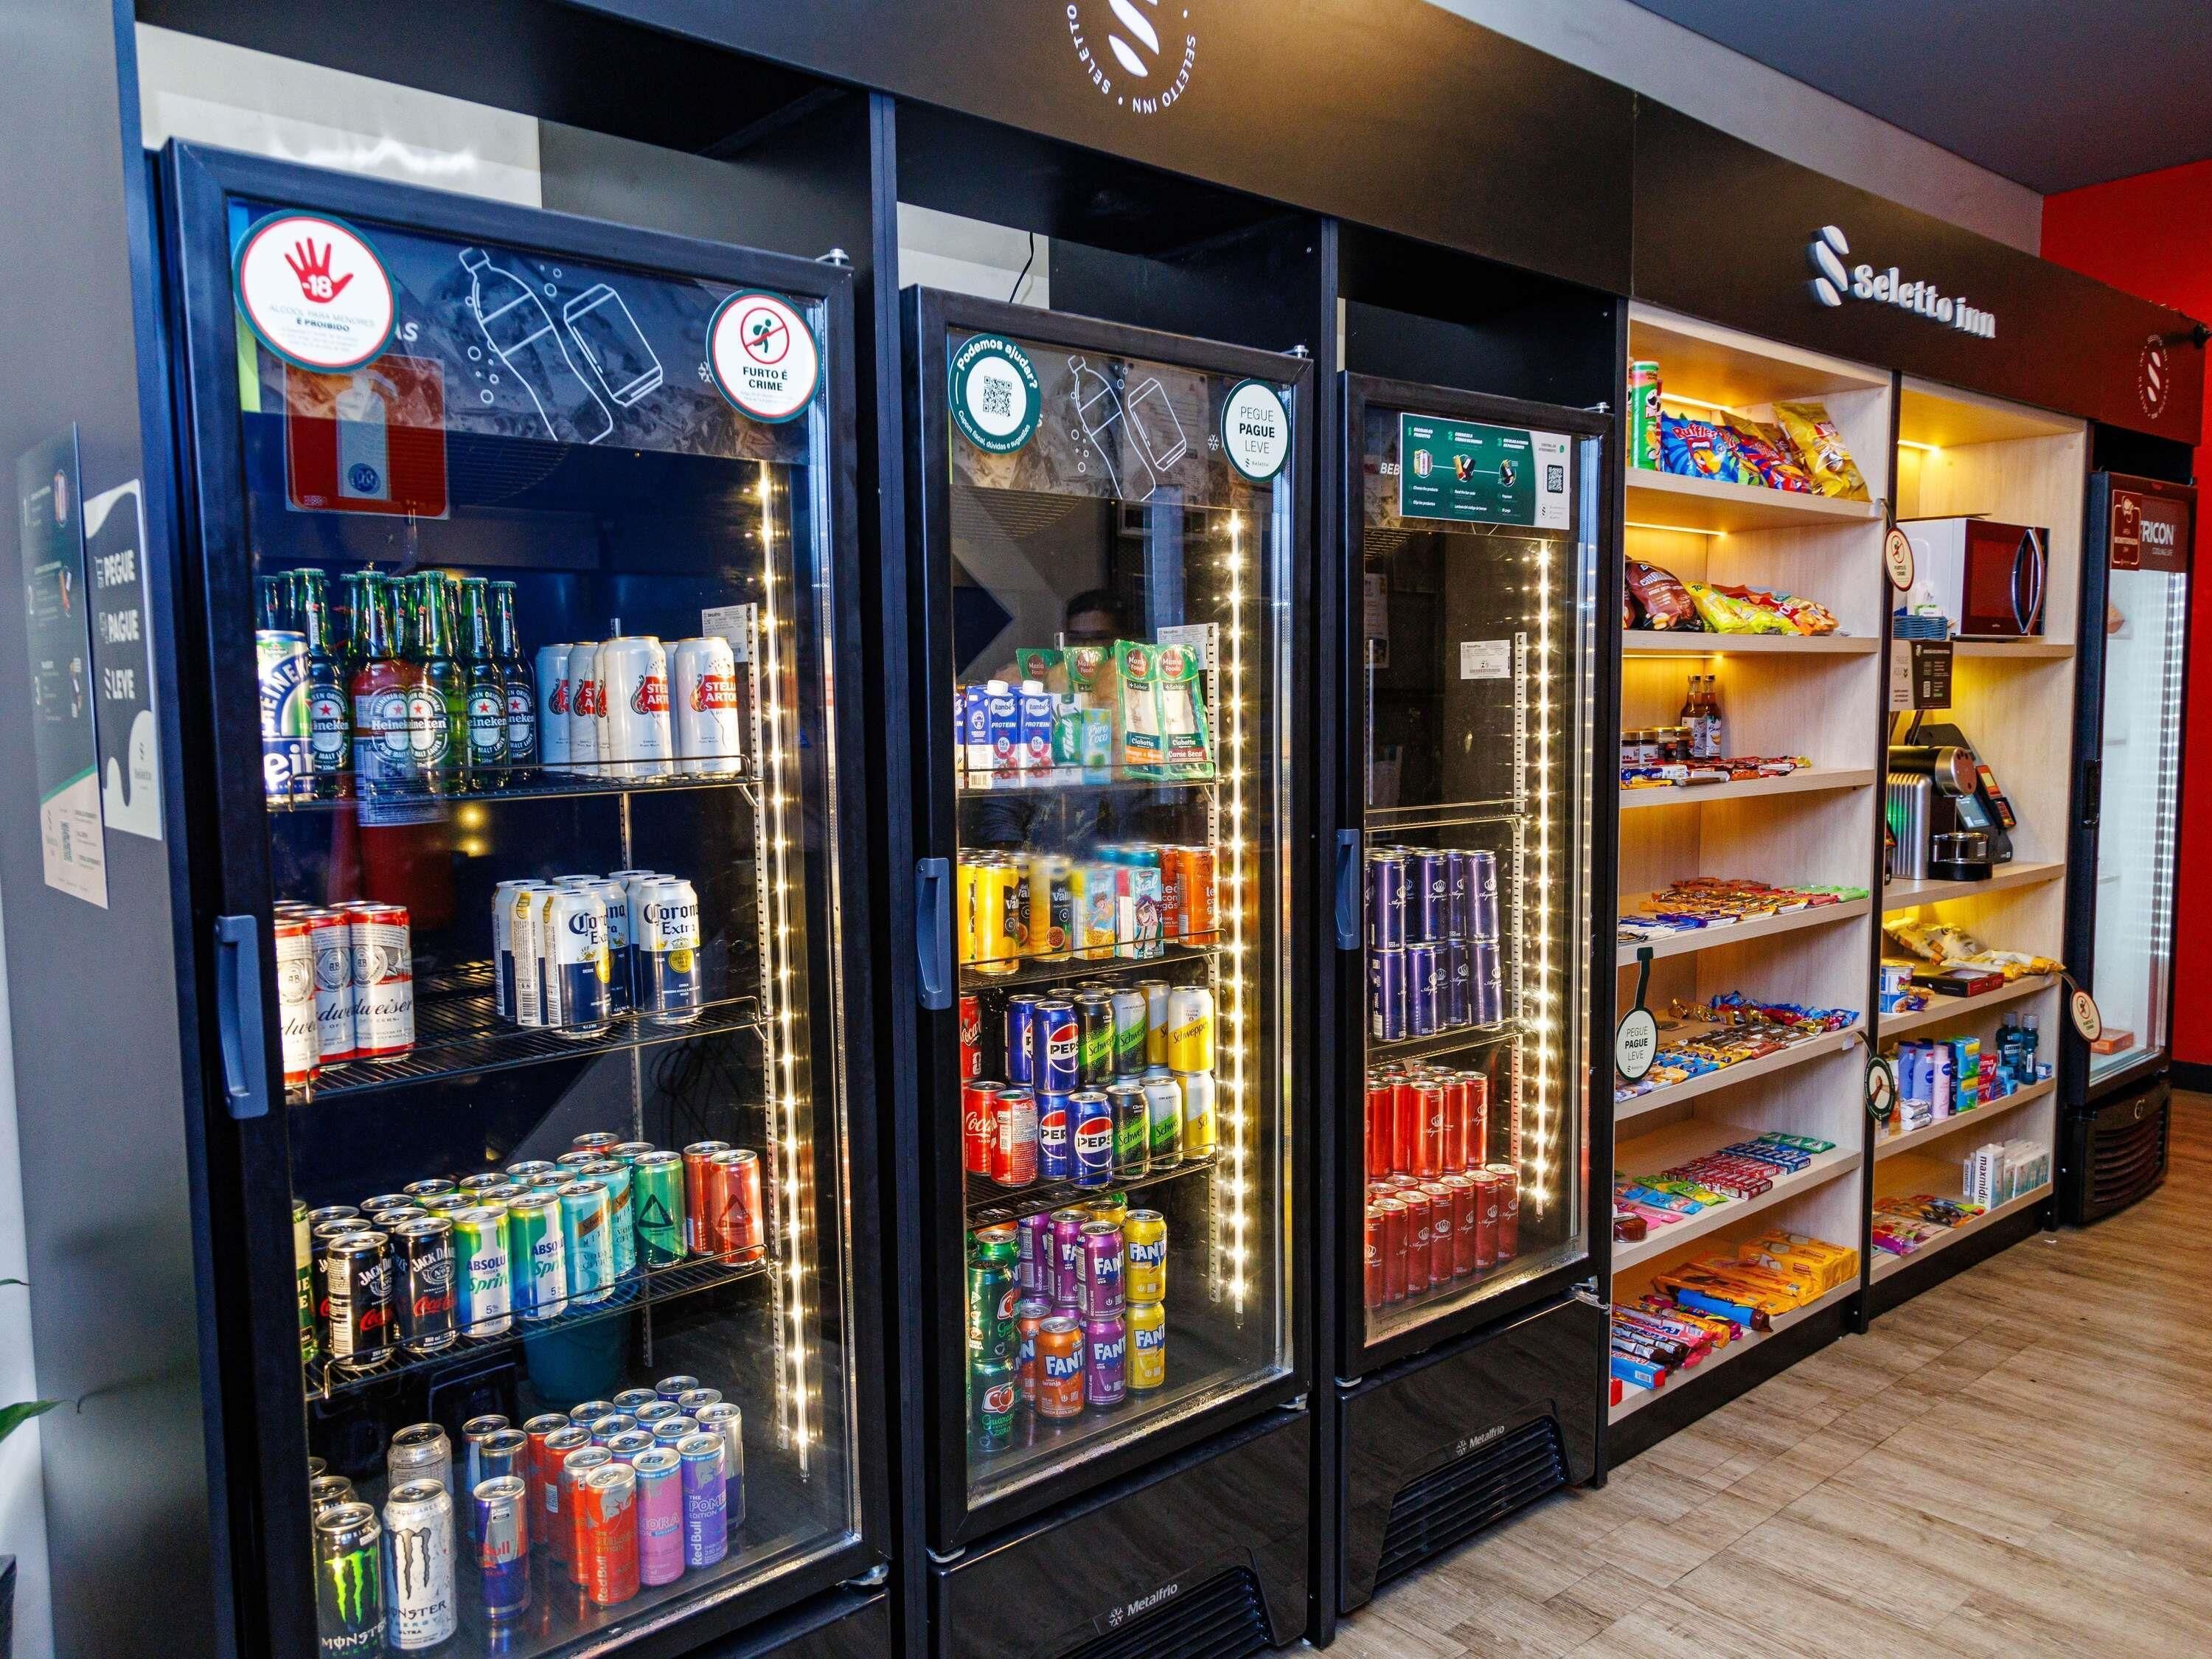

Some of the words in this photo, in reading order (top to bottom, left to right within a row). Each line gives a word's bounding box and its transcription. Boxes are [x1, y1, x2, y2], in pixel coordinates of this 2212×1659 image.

[1067, 4, 1110, 94] SELETTO
[1162, 35, 1196, 107] SELETTO
[1133, 97, 1158, 114] INN
[1854, 264, 1953, 323] Seletto
[1955, 297, 1996, 338] inn
[305, 319, 349, 332] PROIBIDO
[957, 338, 1004, 372] Podemos
[1005, 344, 1038, 389] ajudar?
[742, 366, 779, 379] FURTO
[782, 369, 787, 380] É
[748, 379, 783, 392] CRIME
[1240, 406, 1274, 422] PEGUE
[1239, 422, 1275, 438] PAGUE
[1447, 431, 1453, 441] 2
[1672, 422, 1719, 441] Ruffles
[1245, 439, 1270, 454] LEVE
[103, 549, 136, 588] PEGUE
[108, 609, 139, 643] PAGUE
[111, 668, 135, 700] LEVE
[1131, 738, 1155, 747] Ciabatta
[1172, 738, 1196, 746] Ciabatta
[1627, 1026, 1649, 1037] PEGUE
[1625, 1037, 1649, 1049] PAGUE
[1628, 1050, 1644, 1061] LEVE
[413, 1255, 436, 1273] JACK
[1469, 1425, 1505, 1448] Metalfrio
[690, 1520, 702, 1541] Bull
[691, 1543, 703, 1565] Red
[1127, 1583, 1178, 1617] Metalfrio
